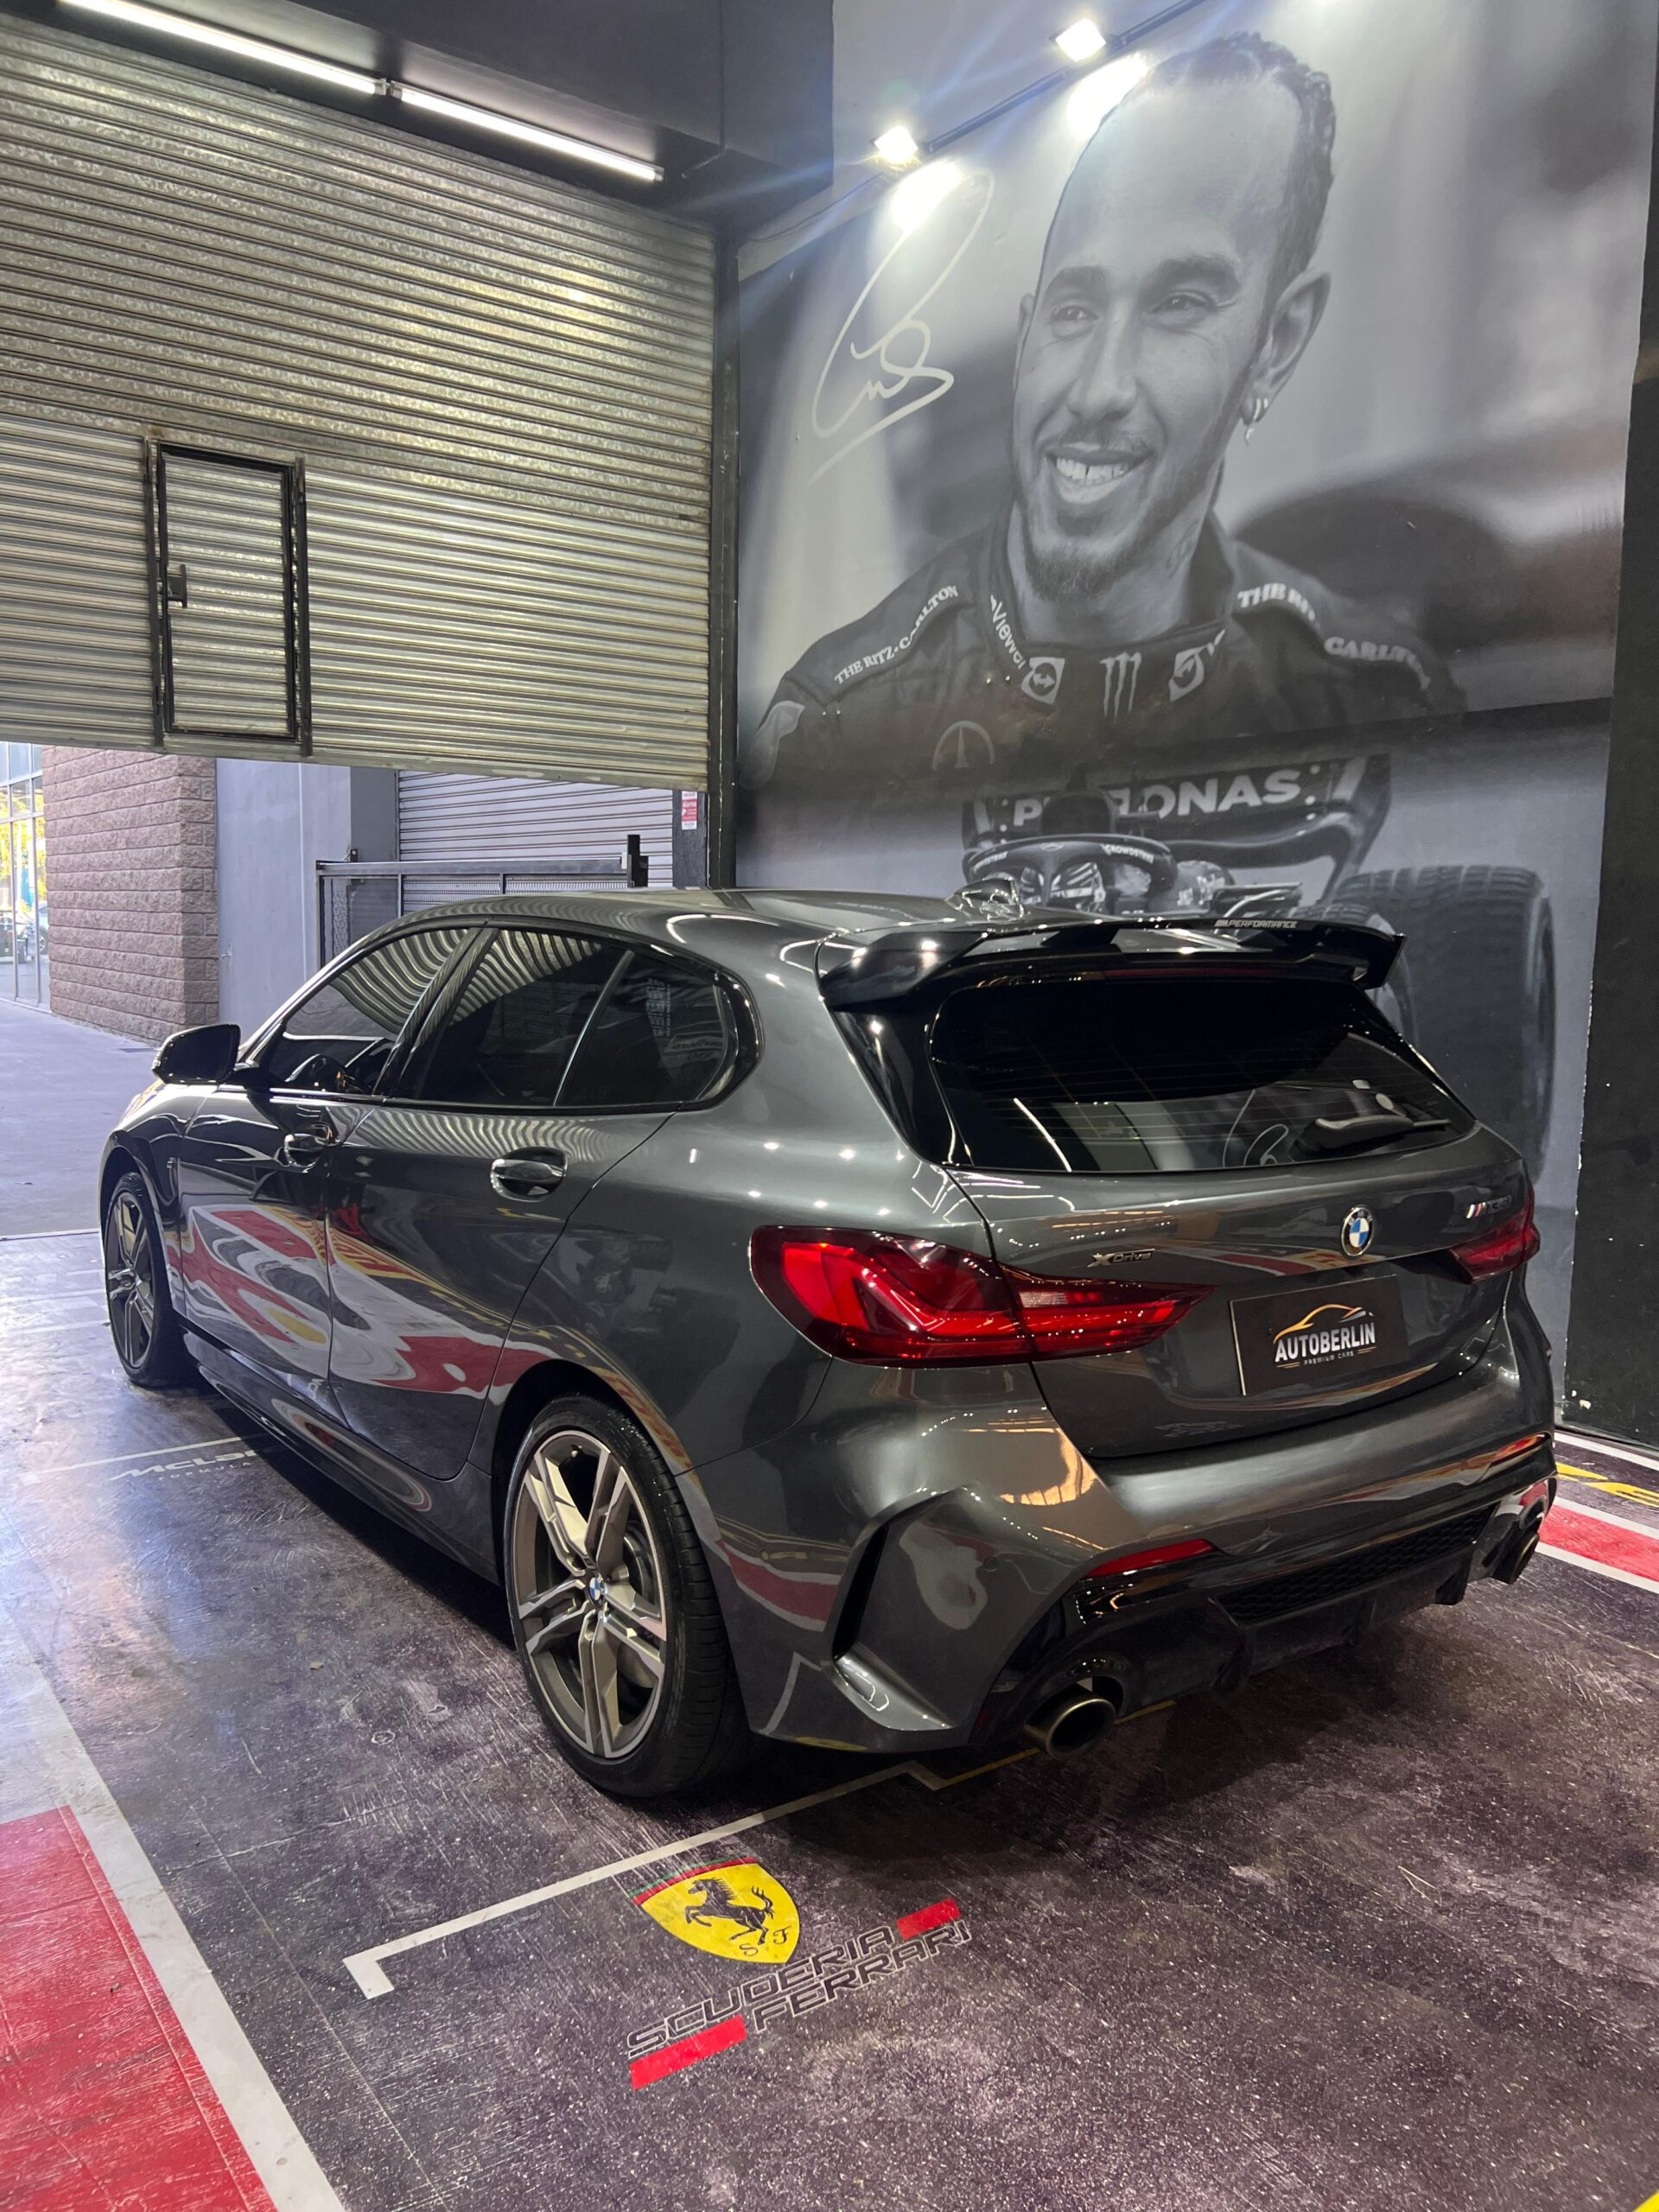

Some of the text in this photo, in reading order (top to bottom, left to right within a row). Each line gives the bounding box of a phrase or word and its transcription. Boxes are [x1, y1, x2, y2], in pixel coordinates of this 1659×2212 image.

[835, 660, 863, 685] THE
[1014, 769, 1302, 827] PONAS
[1274, 1322, 1376, 1363] AUTOBERLIN
[1303, 1354, 1335, 1365] PREMIUM
[627, 1925, 894, 2059] SCUDERIA
[753, 1919, 973, 2034] FERRARI
